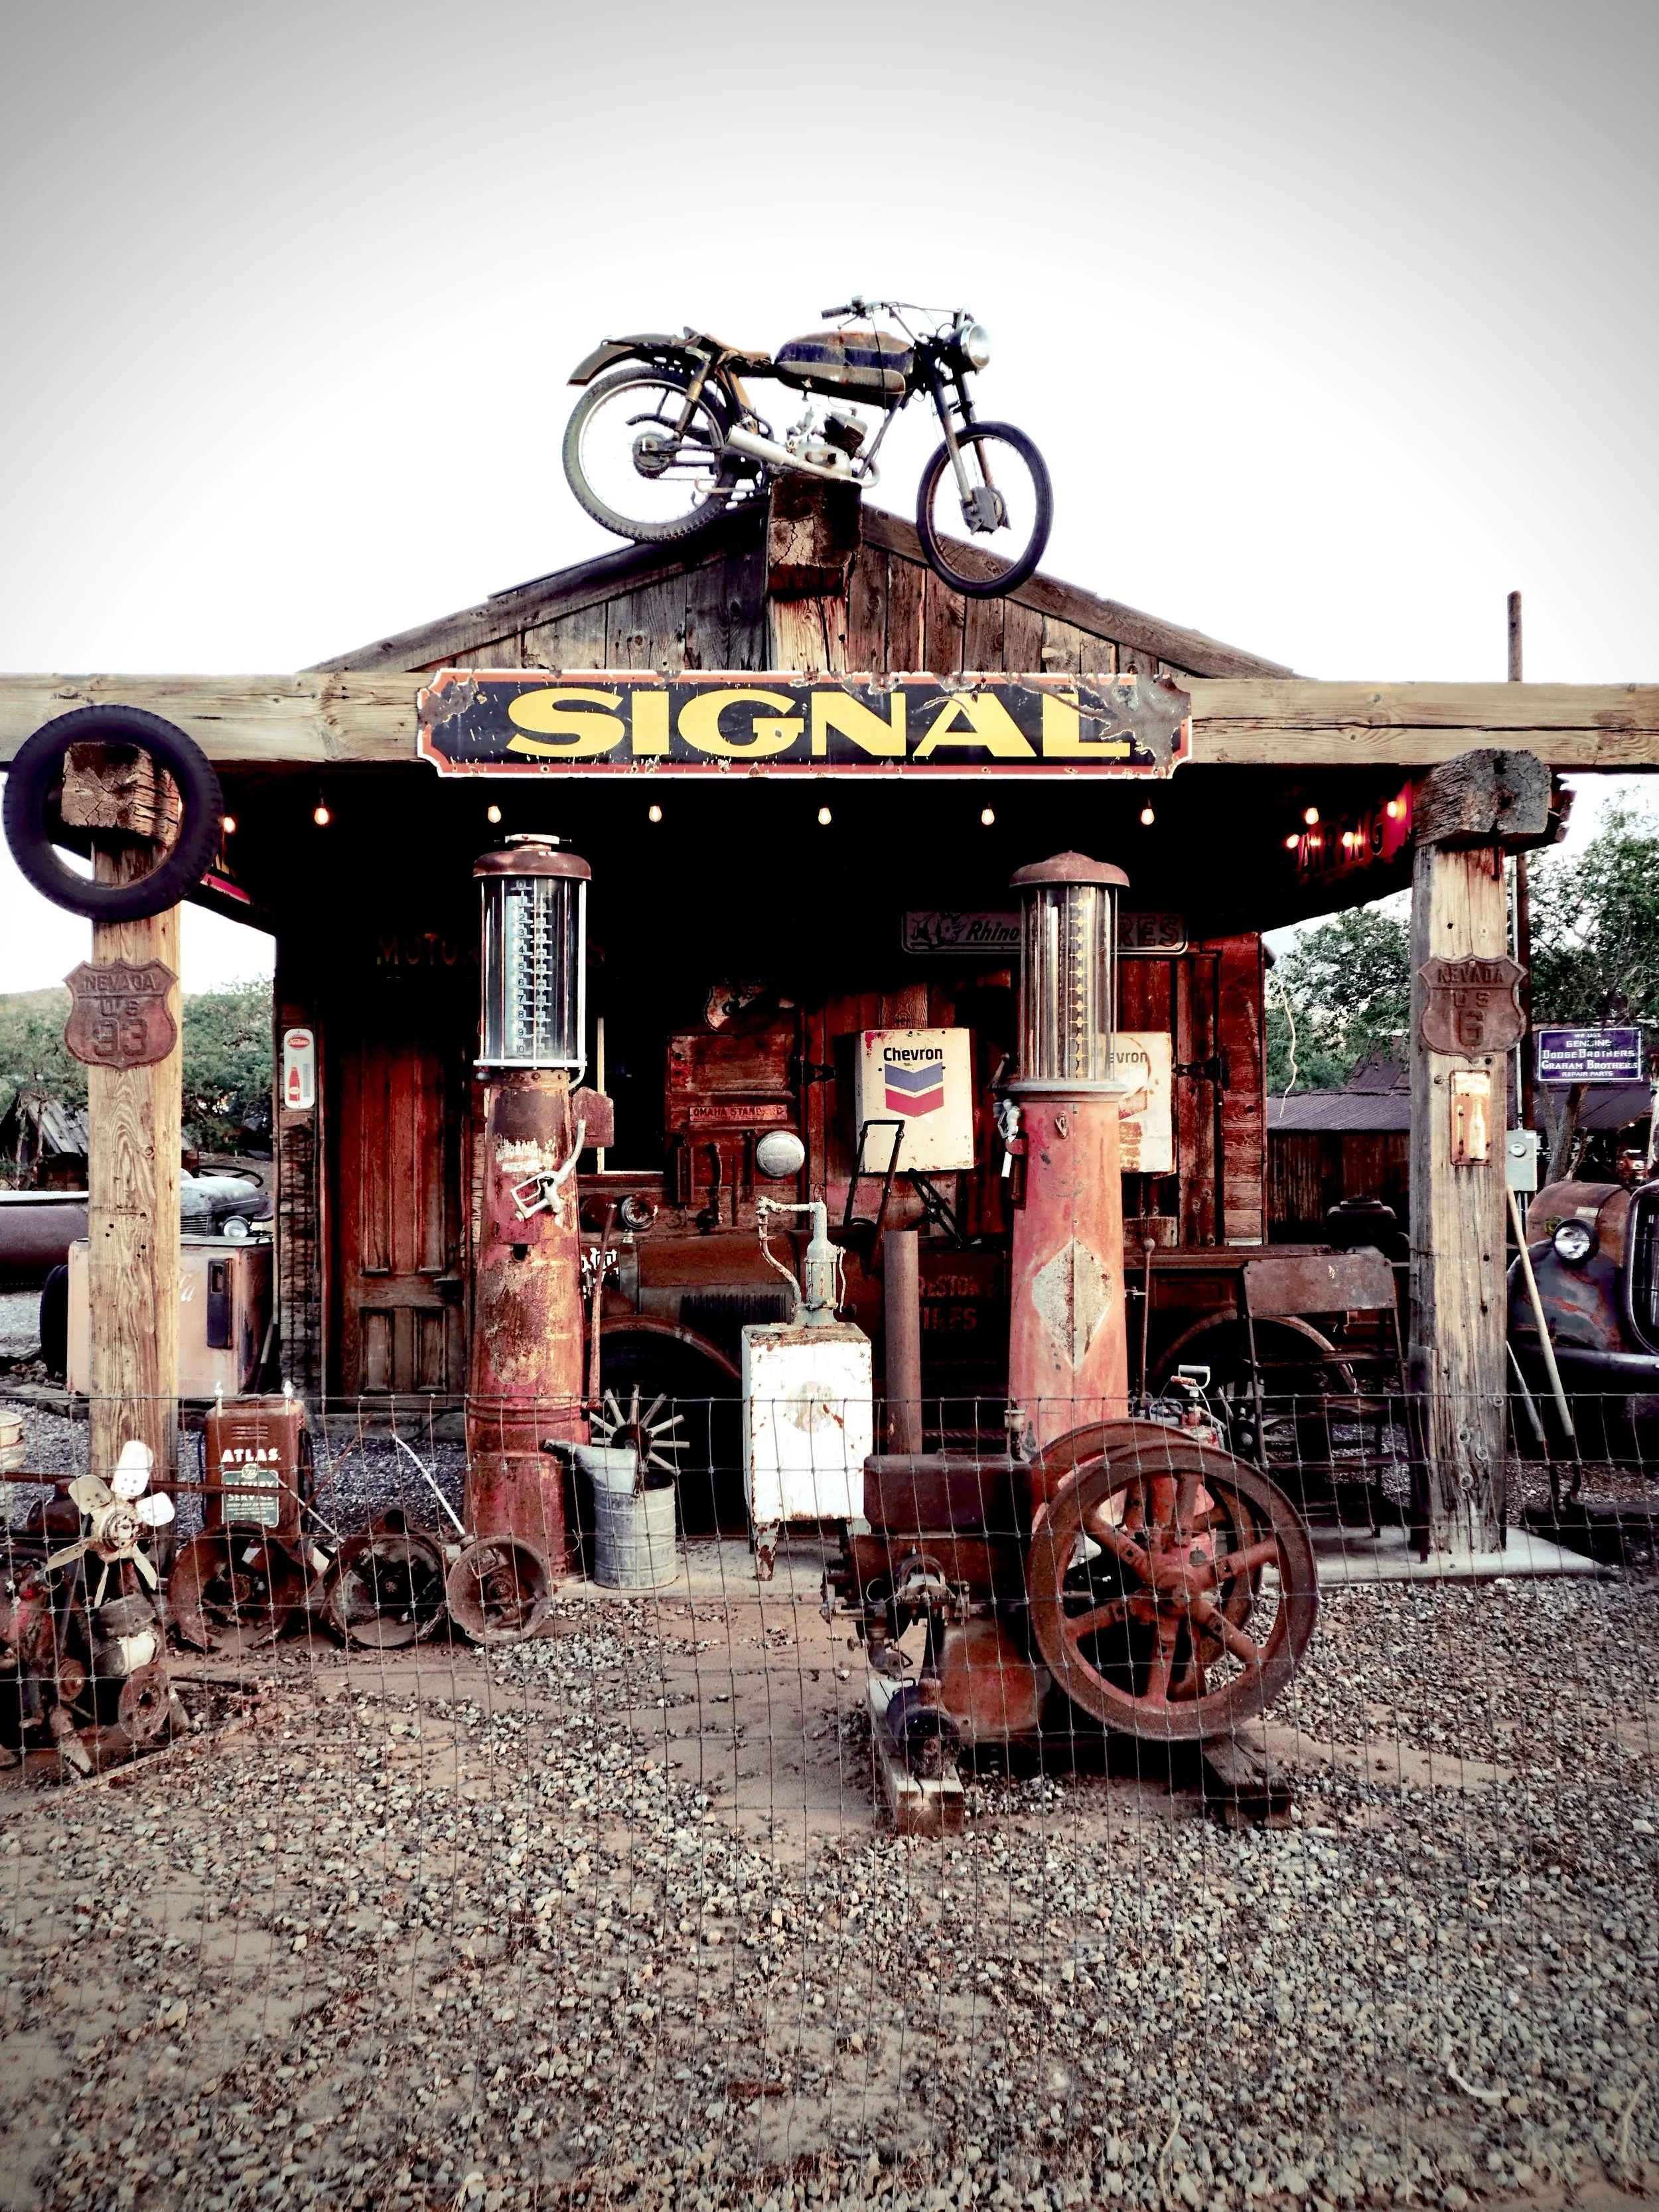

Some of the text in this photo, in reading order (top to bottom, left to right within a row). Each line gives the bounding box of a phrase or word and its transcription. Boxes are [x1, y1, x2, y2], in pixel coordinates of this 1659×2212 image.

[506, 688, 1130, 757] SIGNAL
[966, 920, 1020, 940] Rhino
[84, 974, 157, 991] NEVADA
[1437, 966, 1504, 983] NEVADA
[1459, 1008, 1484, 1046] 6
[92, 1018, 147, 1056] 93
[883, 1047, 942, 1061] Chevron
[1542, 1049, 1635, 1059] DODGE BROTHERS
[1542, 1060, 1638, 1069] GRAHAM BROTHERS
[693, 1106, 784, 1117] OMAHA STANDD
[221, 1448, 279, 1463] ATLAS
